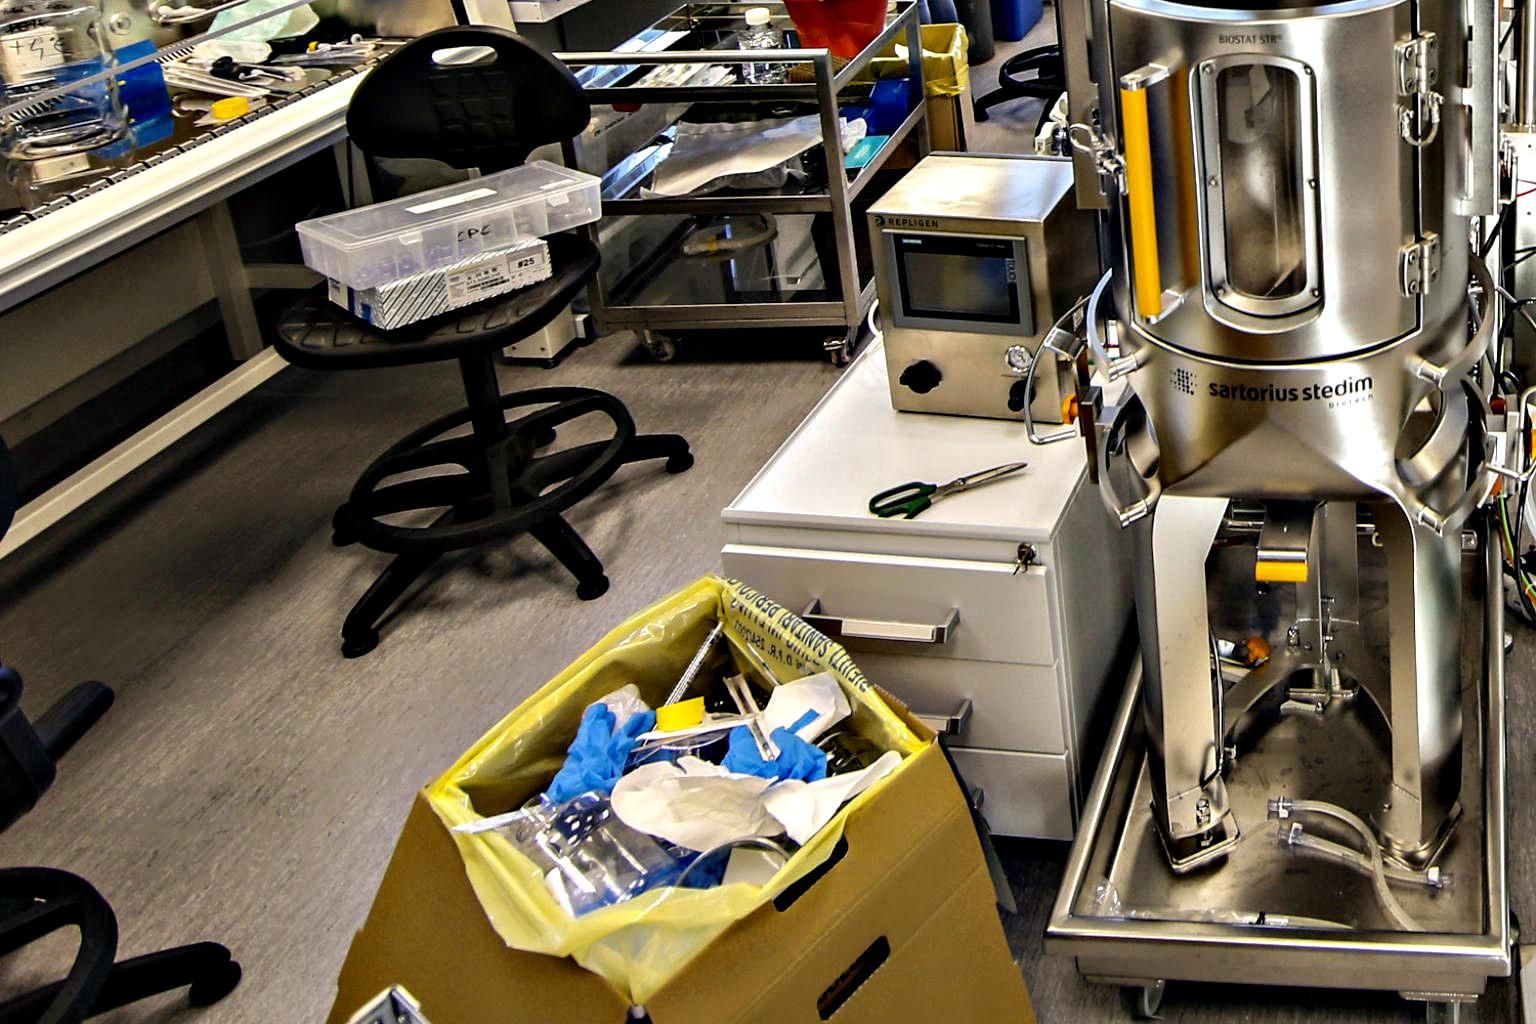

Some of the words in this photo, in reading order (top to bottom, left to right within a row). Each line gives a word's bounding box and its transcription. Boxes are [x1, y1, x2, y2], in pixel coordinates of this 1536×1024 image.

[1218, 34, 1257, 44] BIOSTAT
[888, 217, 939, 228] REPLIGEN
[1208, 382, 1299, 402] sartorius
[1302, 376, 1373, 402] stedim
[778, 612, 835, 658] SANITARI
